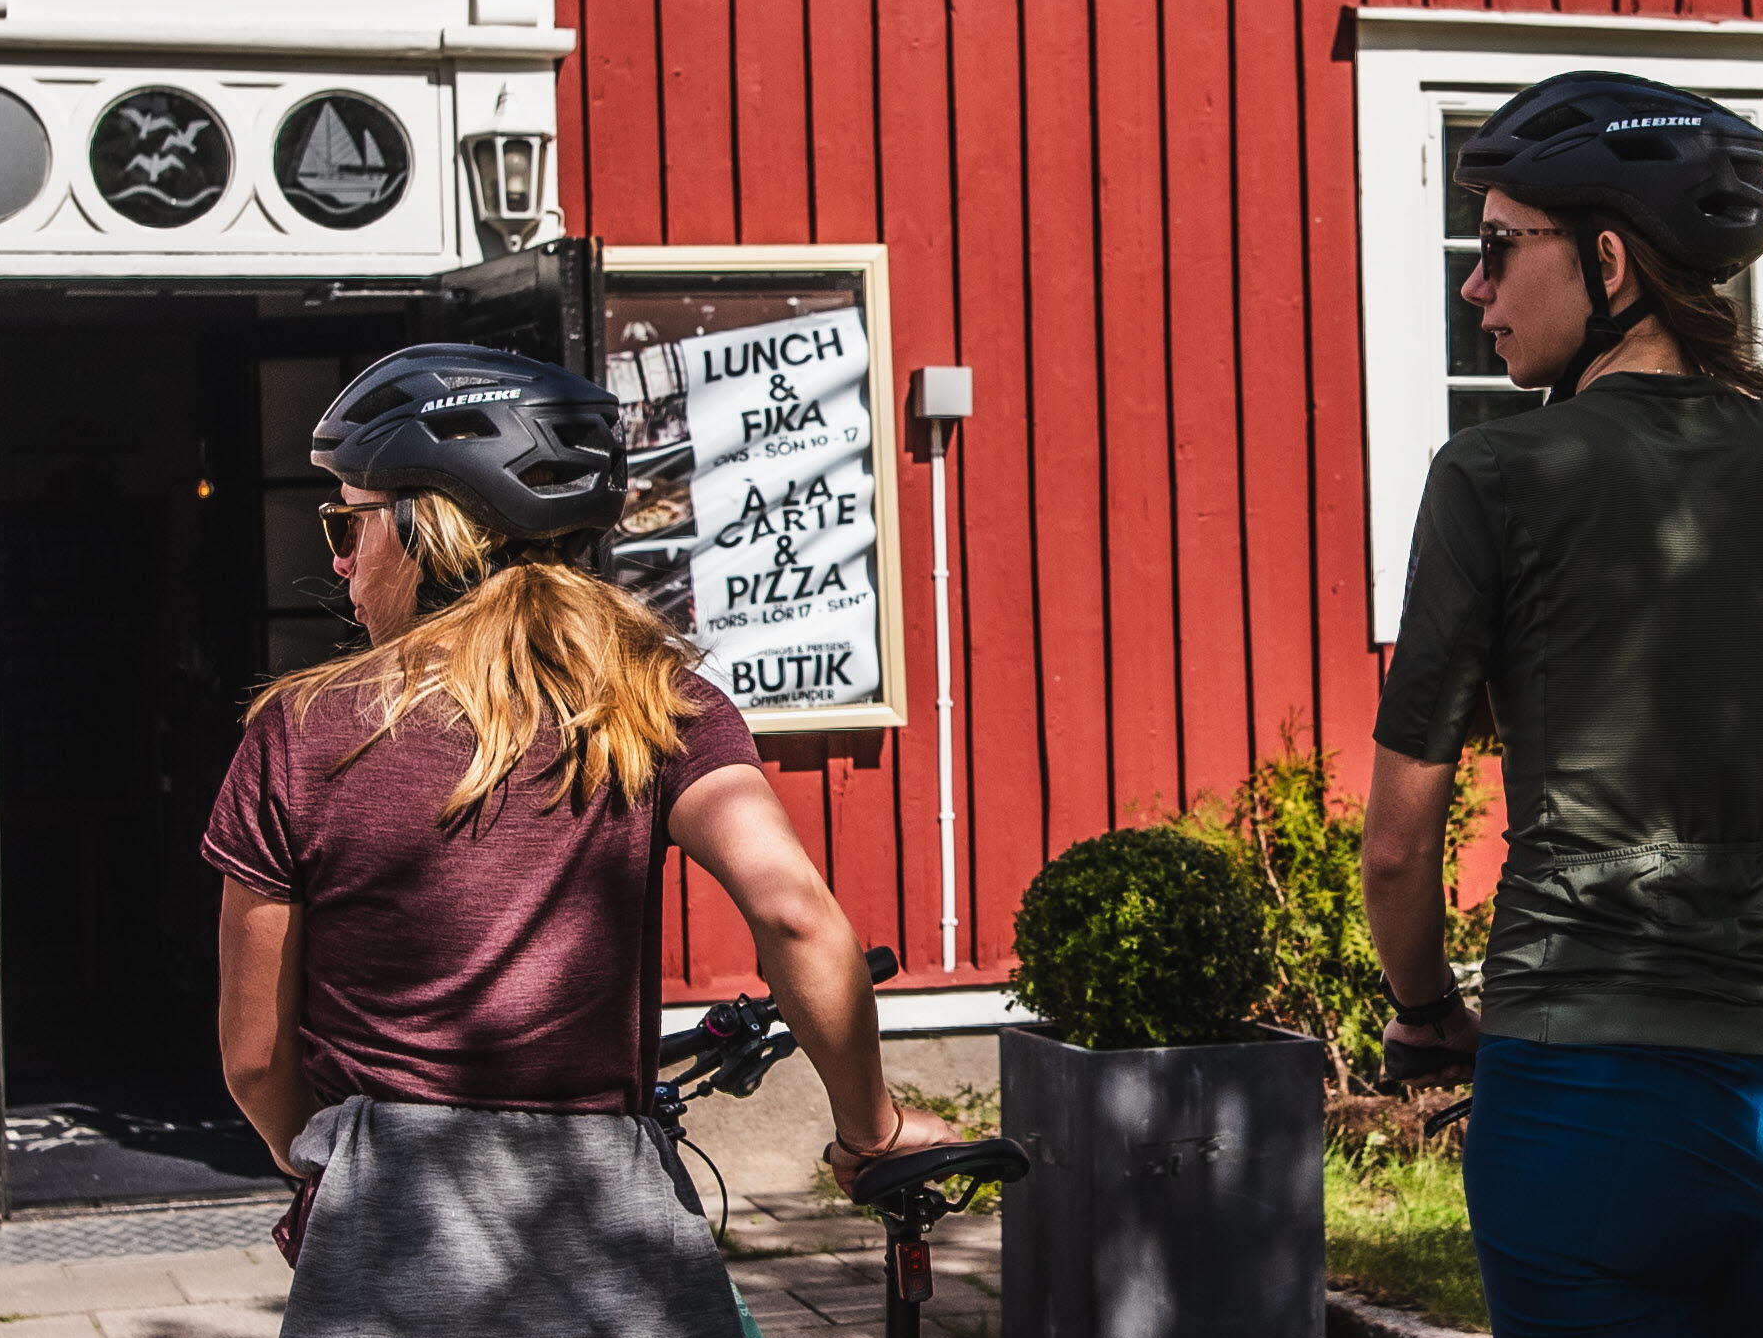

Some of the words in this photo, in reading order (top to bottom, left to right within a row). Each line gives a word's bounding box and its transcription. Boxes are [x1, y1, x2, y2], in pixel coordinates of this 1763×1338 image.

[1606, 116, 1702, 132] ALLEBIKE
[702, 327, 844, 384] LUNCH
[420, 388, 522, 414] ALLEBIKE
[769, 373, 799, 402] &
[741, 399, 827, 444] FIKA
[764, 435, 806, 459] SÖN
[843, 427, 860, 443] 17
[740, 477, 767, 521] À
[781, 475, 833, 507] LA
[715, 493, 856, 548] CARTE
[773, 534, 798, 567] &
[726, 563, 847, 610] PIZZA
[708, 612, 748, 632] TORS
[762, 603, 795, 625] LÖR
[798, 604, 812, 618] 17
[732, 651, 853, 694] BUTIK
